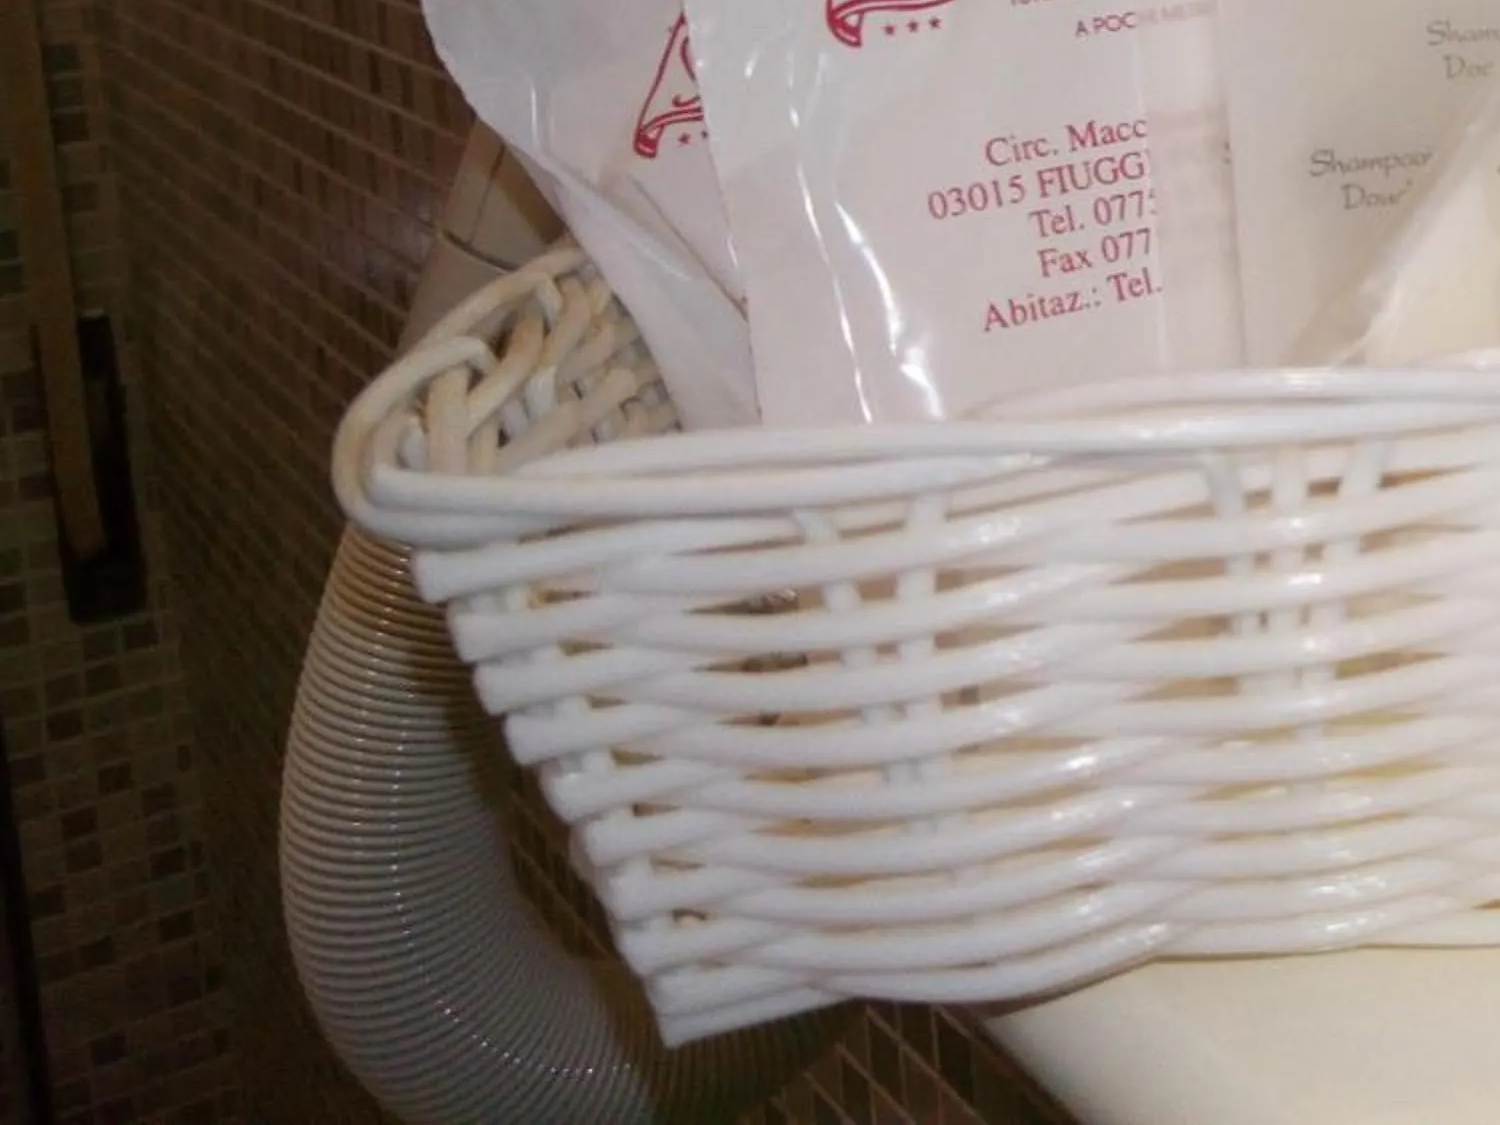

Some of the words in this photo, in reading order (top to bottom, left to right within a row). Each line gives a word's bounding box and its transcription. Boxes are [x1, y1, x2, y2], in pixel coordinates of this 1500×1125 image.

[1074, 19, 1089, 38] A
[1093, 11, 1138, 33] POC
[984, 133, 1060, 167] Circ.
[1066, 119, 1148, 152] Macc
[926, 174, 1027, 221] 03015
[1035, 151, 1150, 199] FIUGG
[1027, 205, 1085, 239] Tel.
[1035, 247, 1094, 279] Fax
[1101, 226, 1152, 264] 077
[1106, 266, 1164, 304] Tel.
